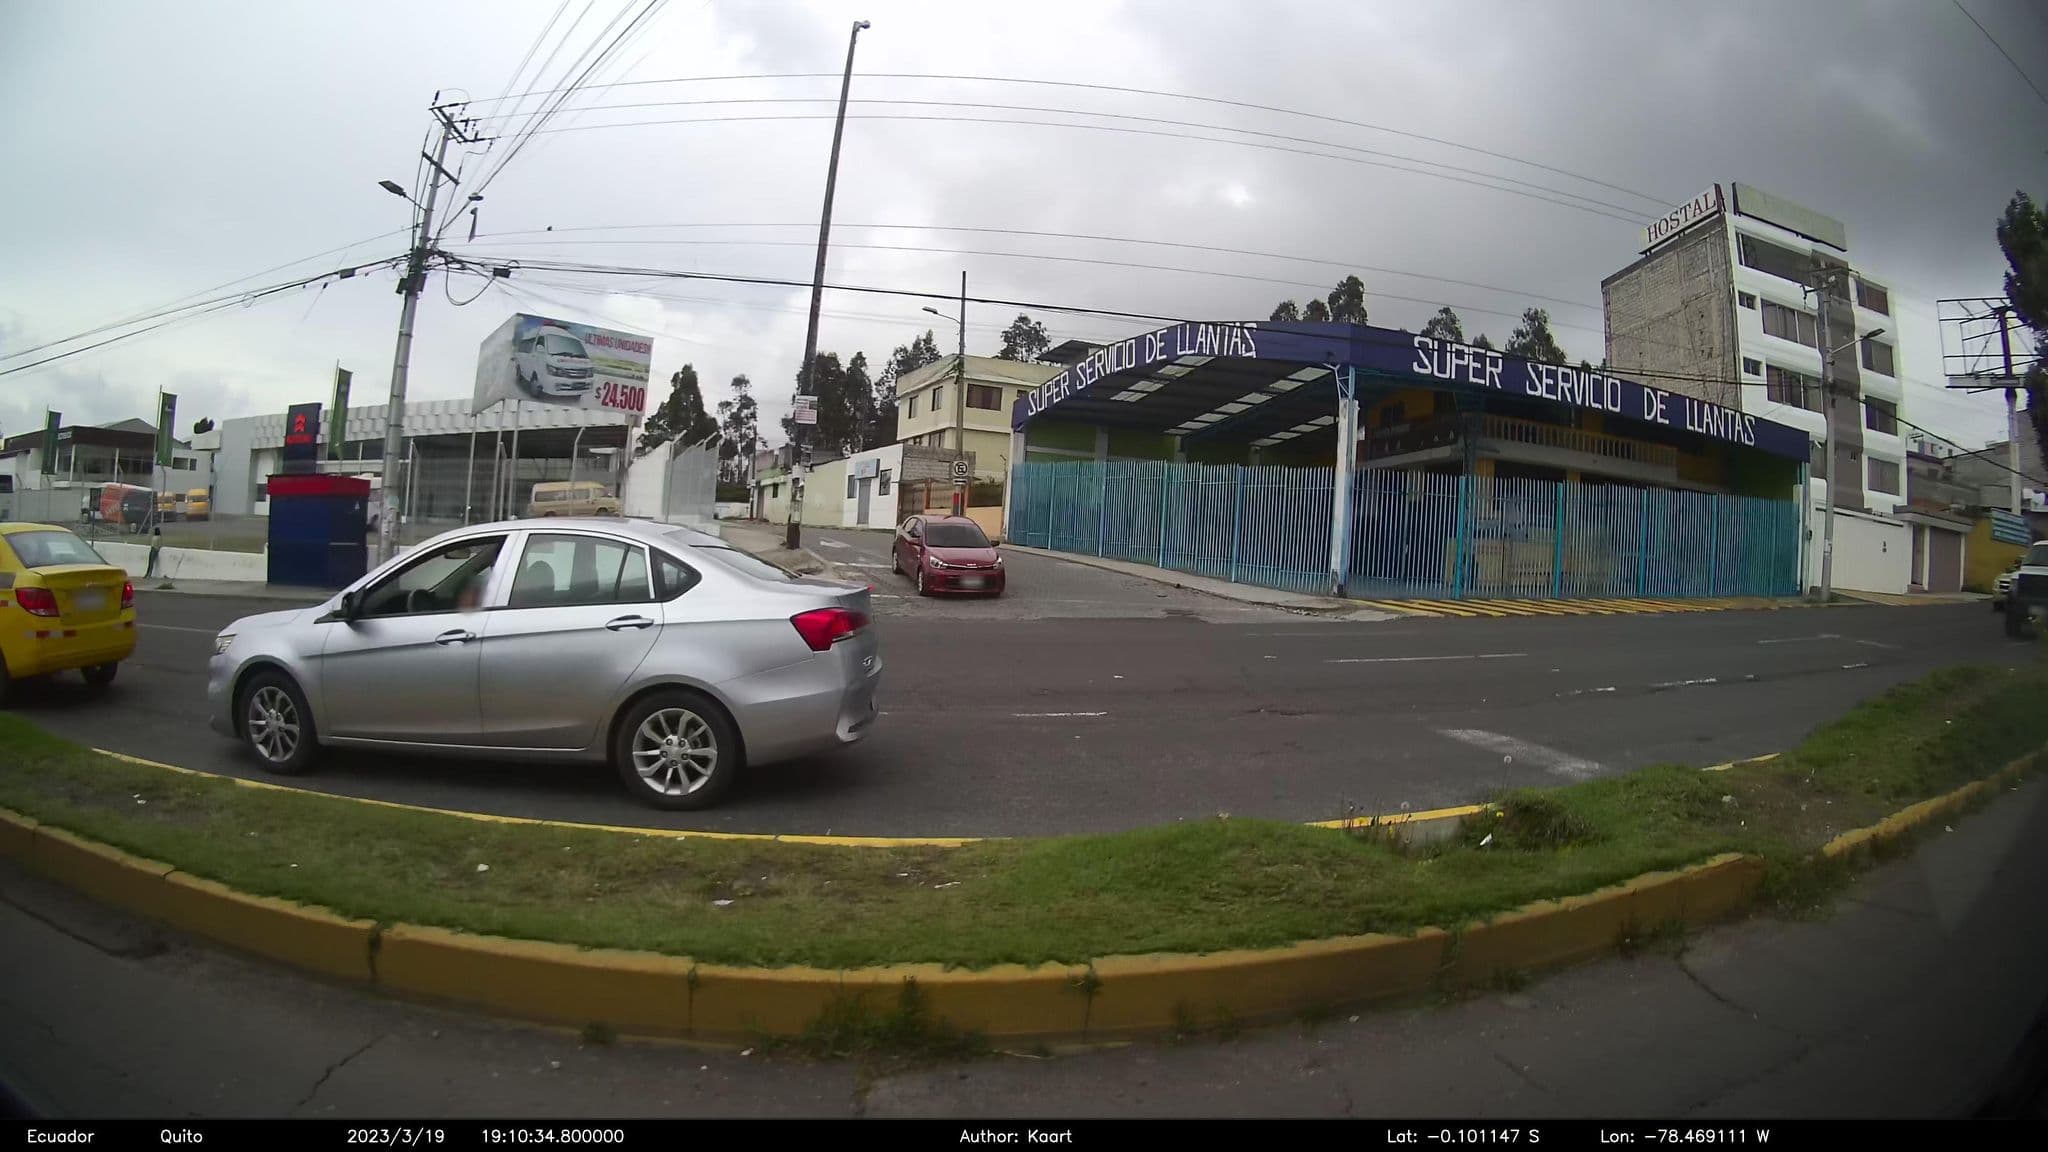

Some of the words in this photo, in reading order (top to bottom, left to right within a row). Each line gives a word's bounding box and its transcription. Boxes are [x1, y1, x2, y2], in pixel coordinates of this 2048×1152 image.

[1647, 192, 1716, 243] HOSTAL
[1028, 371, 1070, 416] SUPER
[1076, 339, 1137, 391] SERVICIO
[1145, 329, 1168, 364] DE
[1176, 322, 1257, 359] LLANTAS
[1412, 335, 1503, 389] SUPER
[1526, 361, 1621, 413] SERVICIO
[1643, 387, 1670, 425] DE
[1686, 398, 1755, 446] LLANTAS
